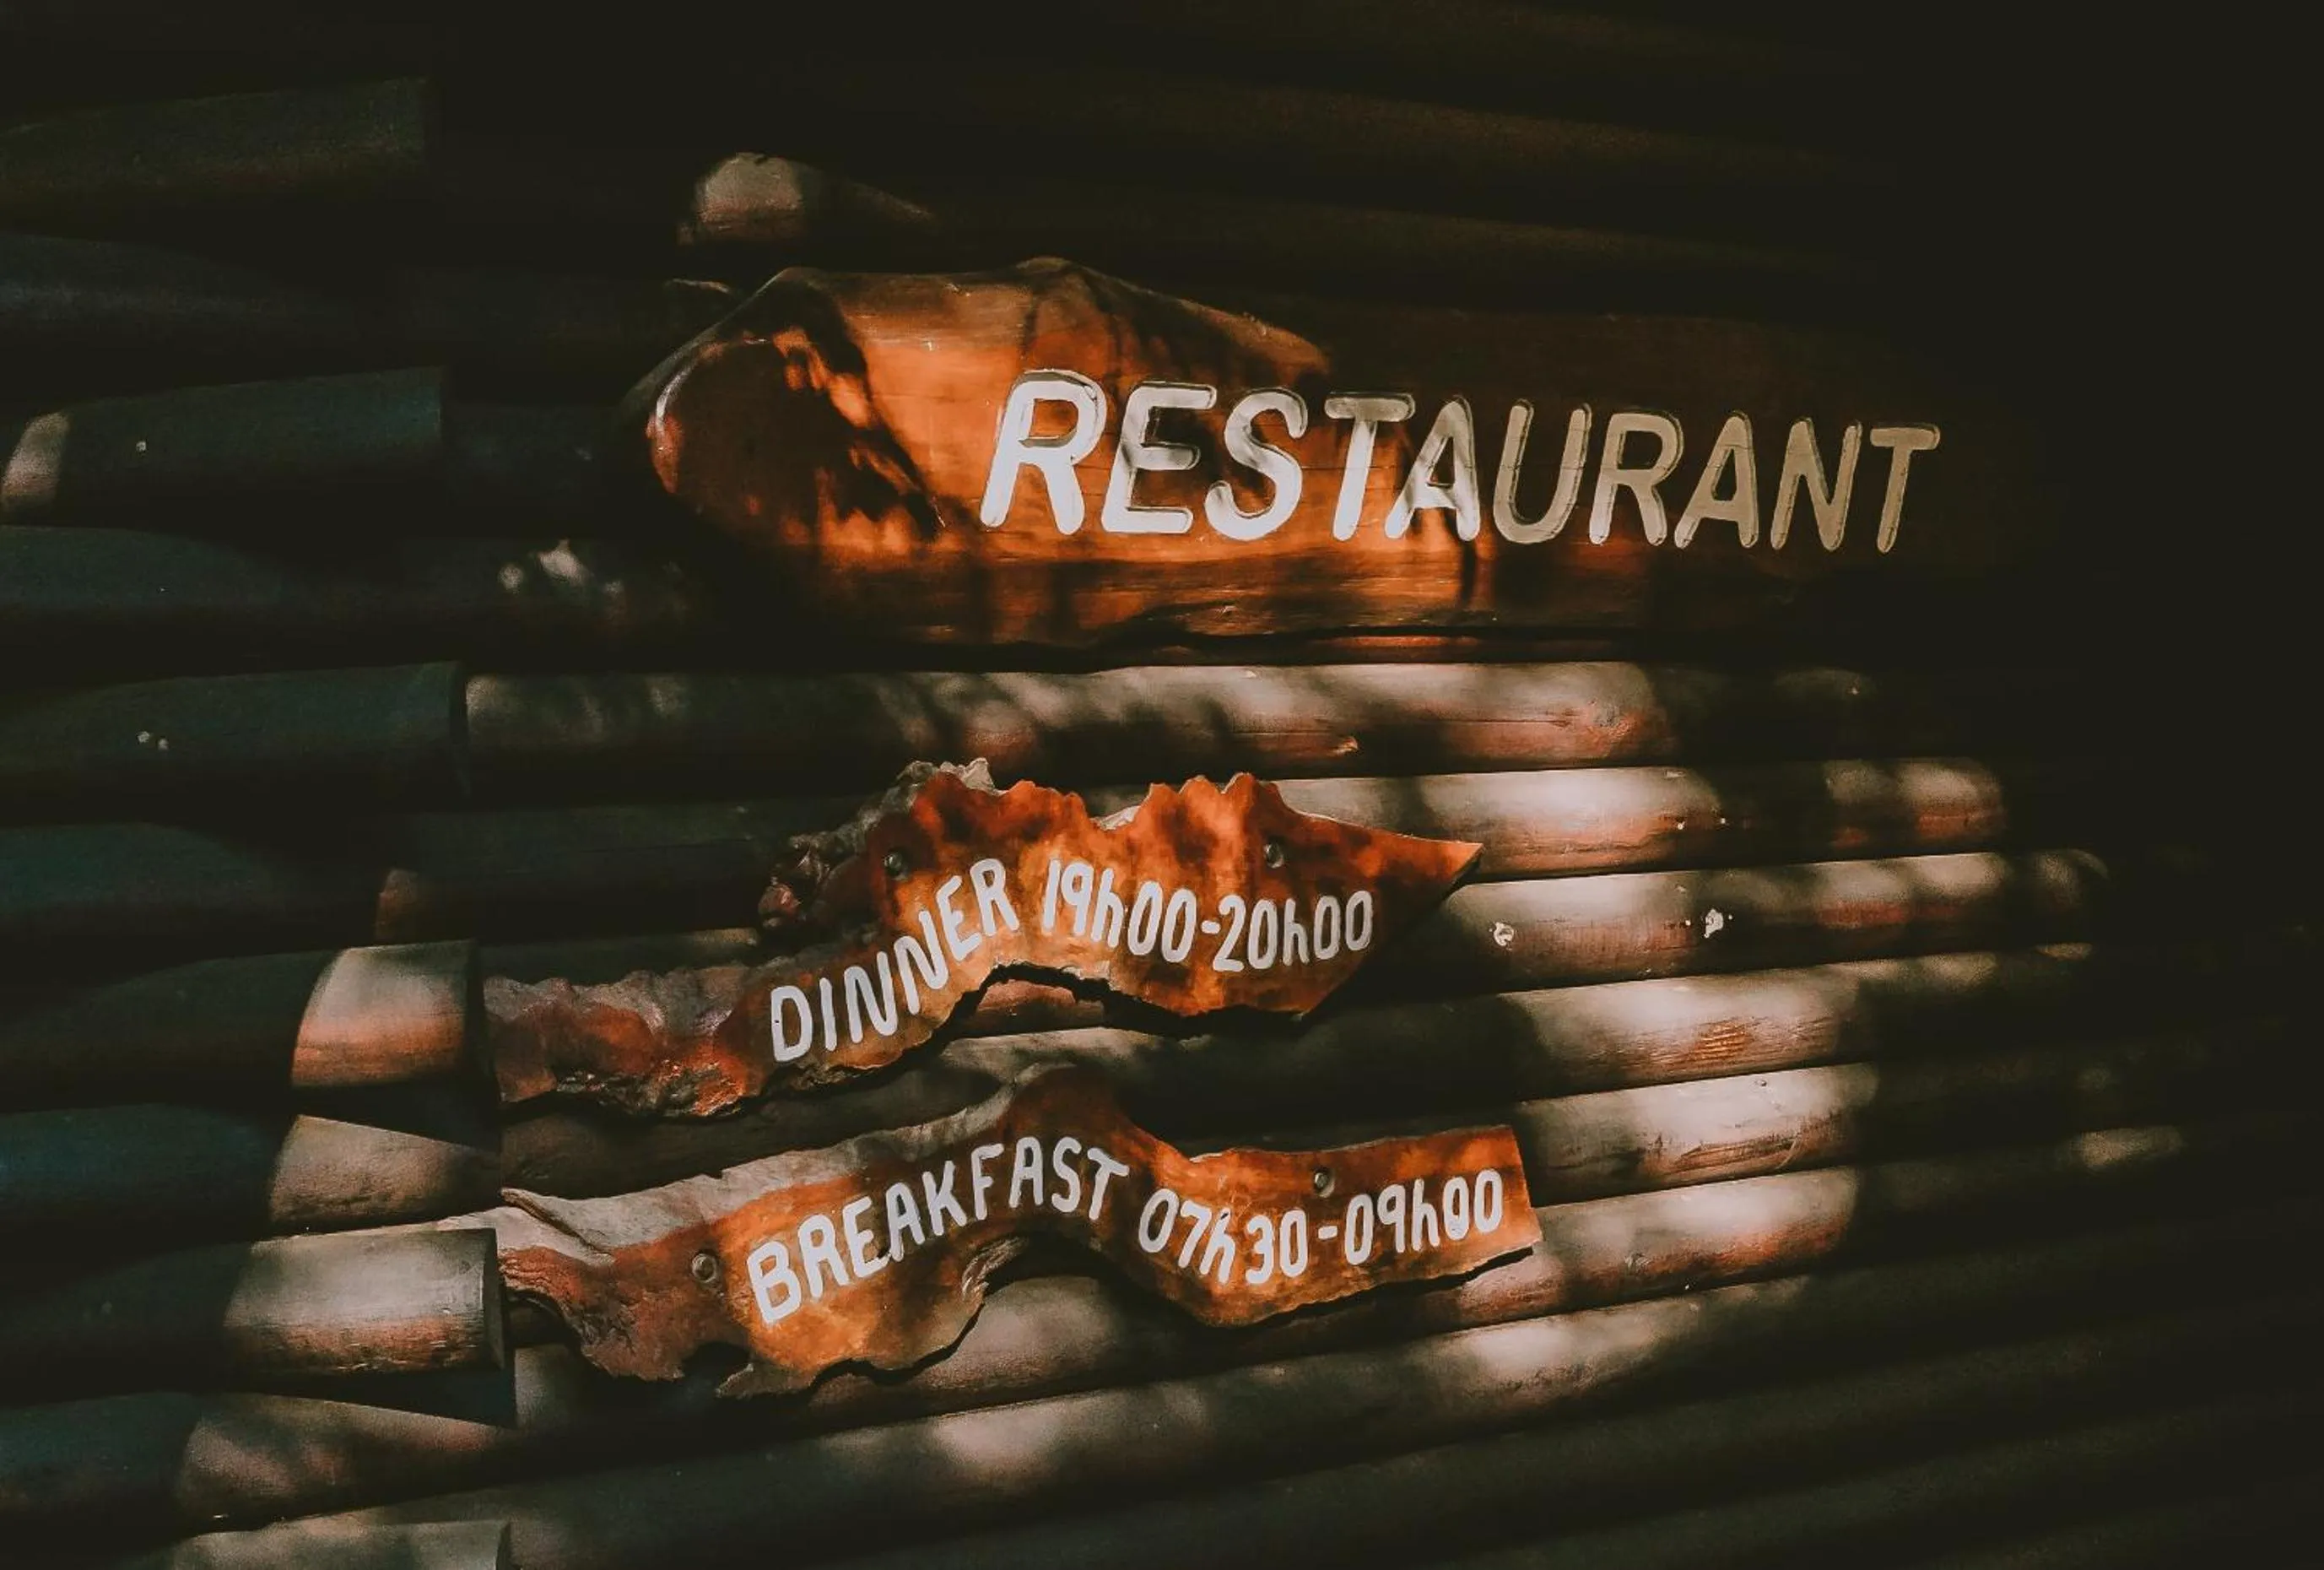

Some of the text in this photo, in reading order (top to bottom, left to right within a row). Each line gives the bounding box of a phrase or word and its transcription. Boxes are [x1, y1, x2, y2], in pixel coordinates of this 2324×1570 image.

[980, 369, 1940, 551] RESTAURANT
[770, 858, 1373, 1063] DINNER 19h00-20h00
[746, 1137, 1129, 1324] BREAKFAST
